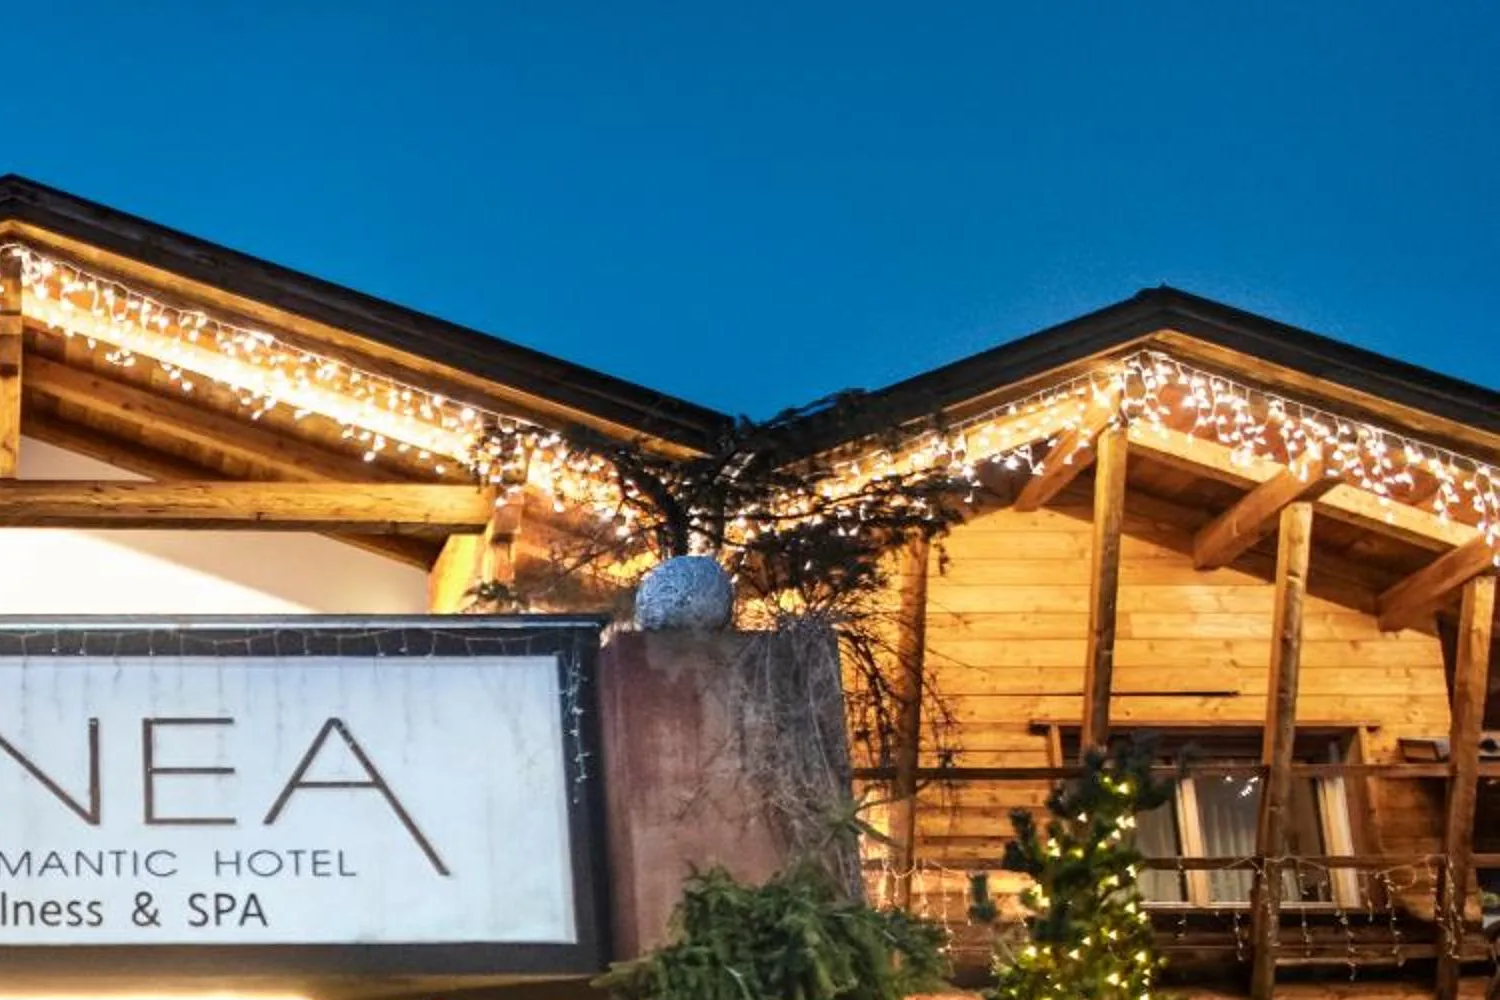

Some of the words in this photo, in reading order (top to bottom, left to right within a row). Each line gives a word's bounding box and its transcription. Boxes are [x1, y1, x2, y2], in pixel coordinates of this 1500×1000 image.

[215, 849, 357, 878] HOTEL
[132, 891, 162, 928] &
[188, 891, 269, 929] SPA
